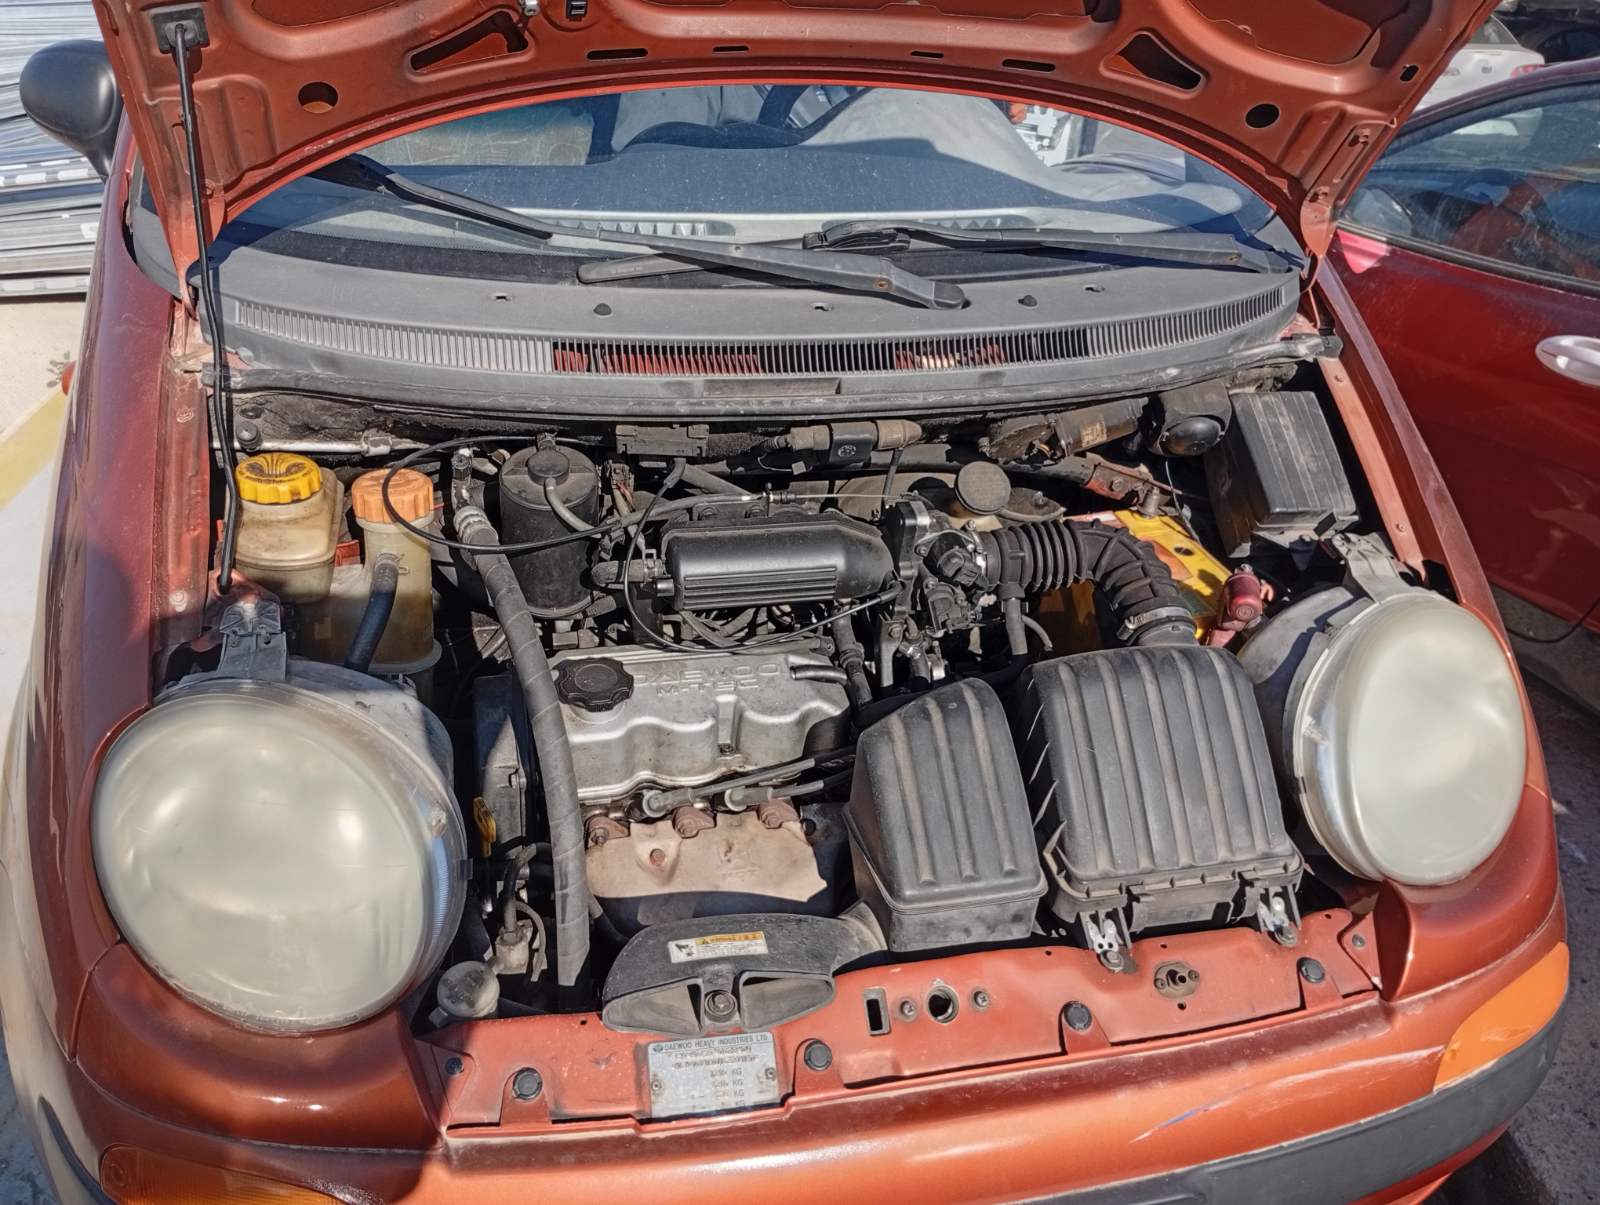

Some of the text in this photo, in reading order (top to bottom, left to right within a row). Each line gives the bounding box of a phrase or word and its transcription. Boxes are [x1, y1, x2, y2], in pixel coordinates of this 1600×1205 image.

[634, 664, 780, 686] DAEWOO
[664, 1042, 693, 1051] DAEWOO
[695, 1039, 715, 1048] HEAVY
[717, 1036, 754, 1045] INDUSTRIES
